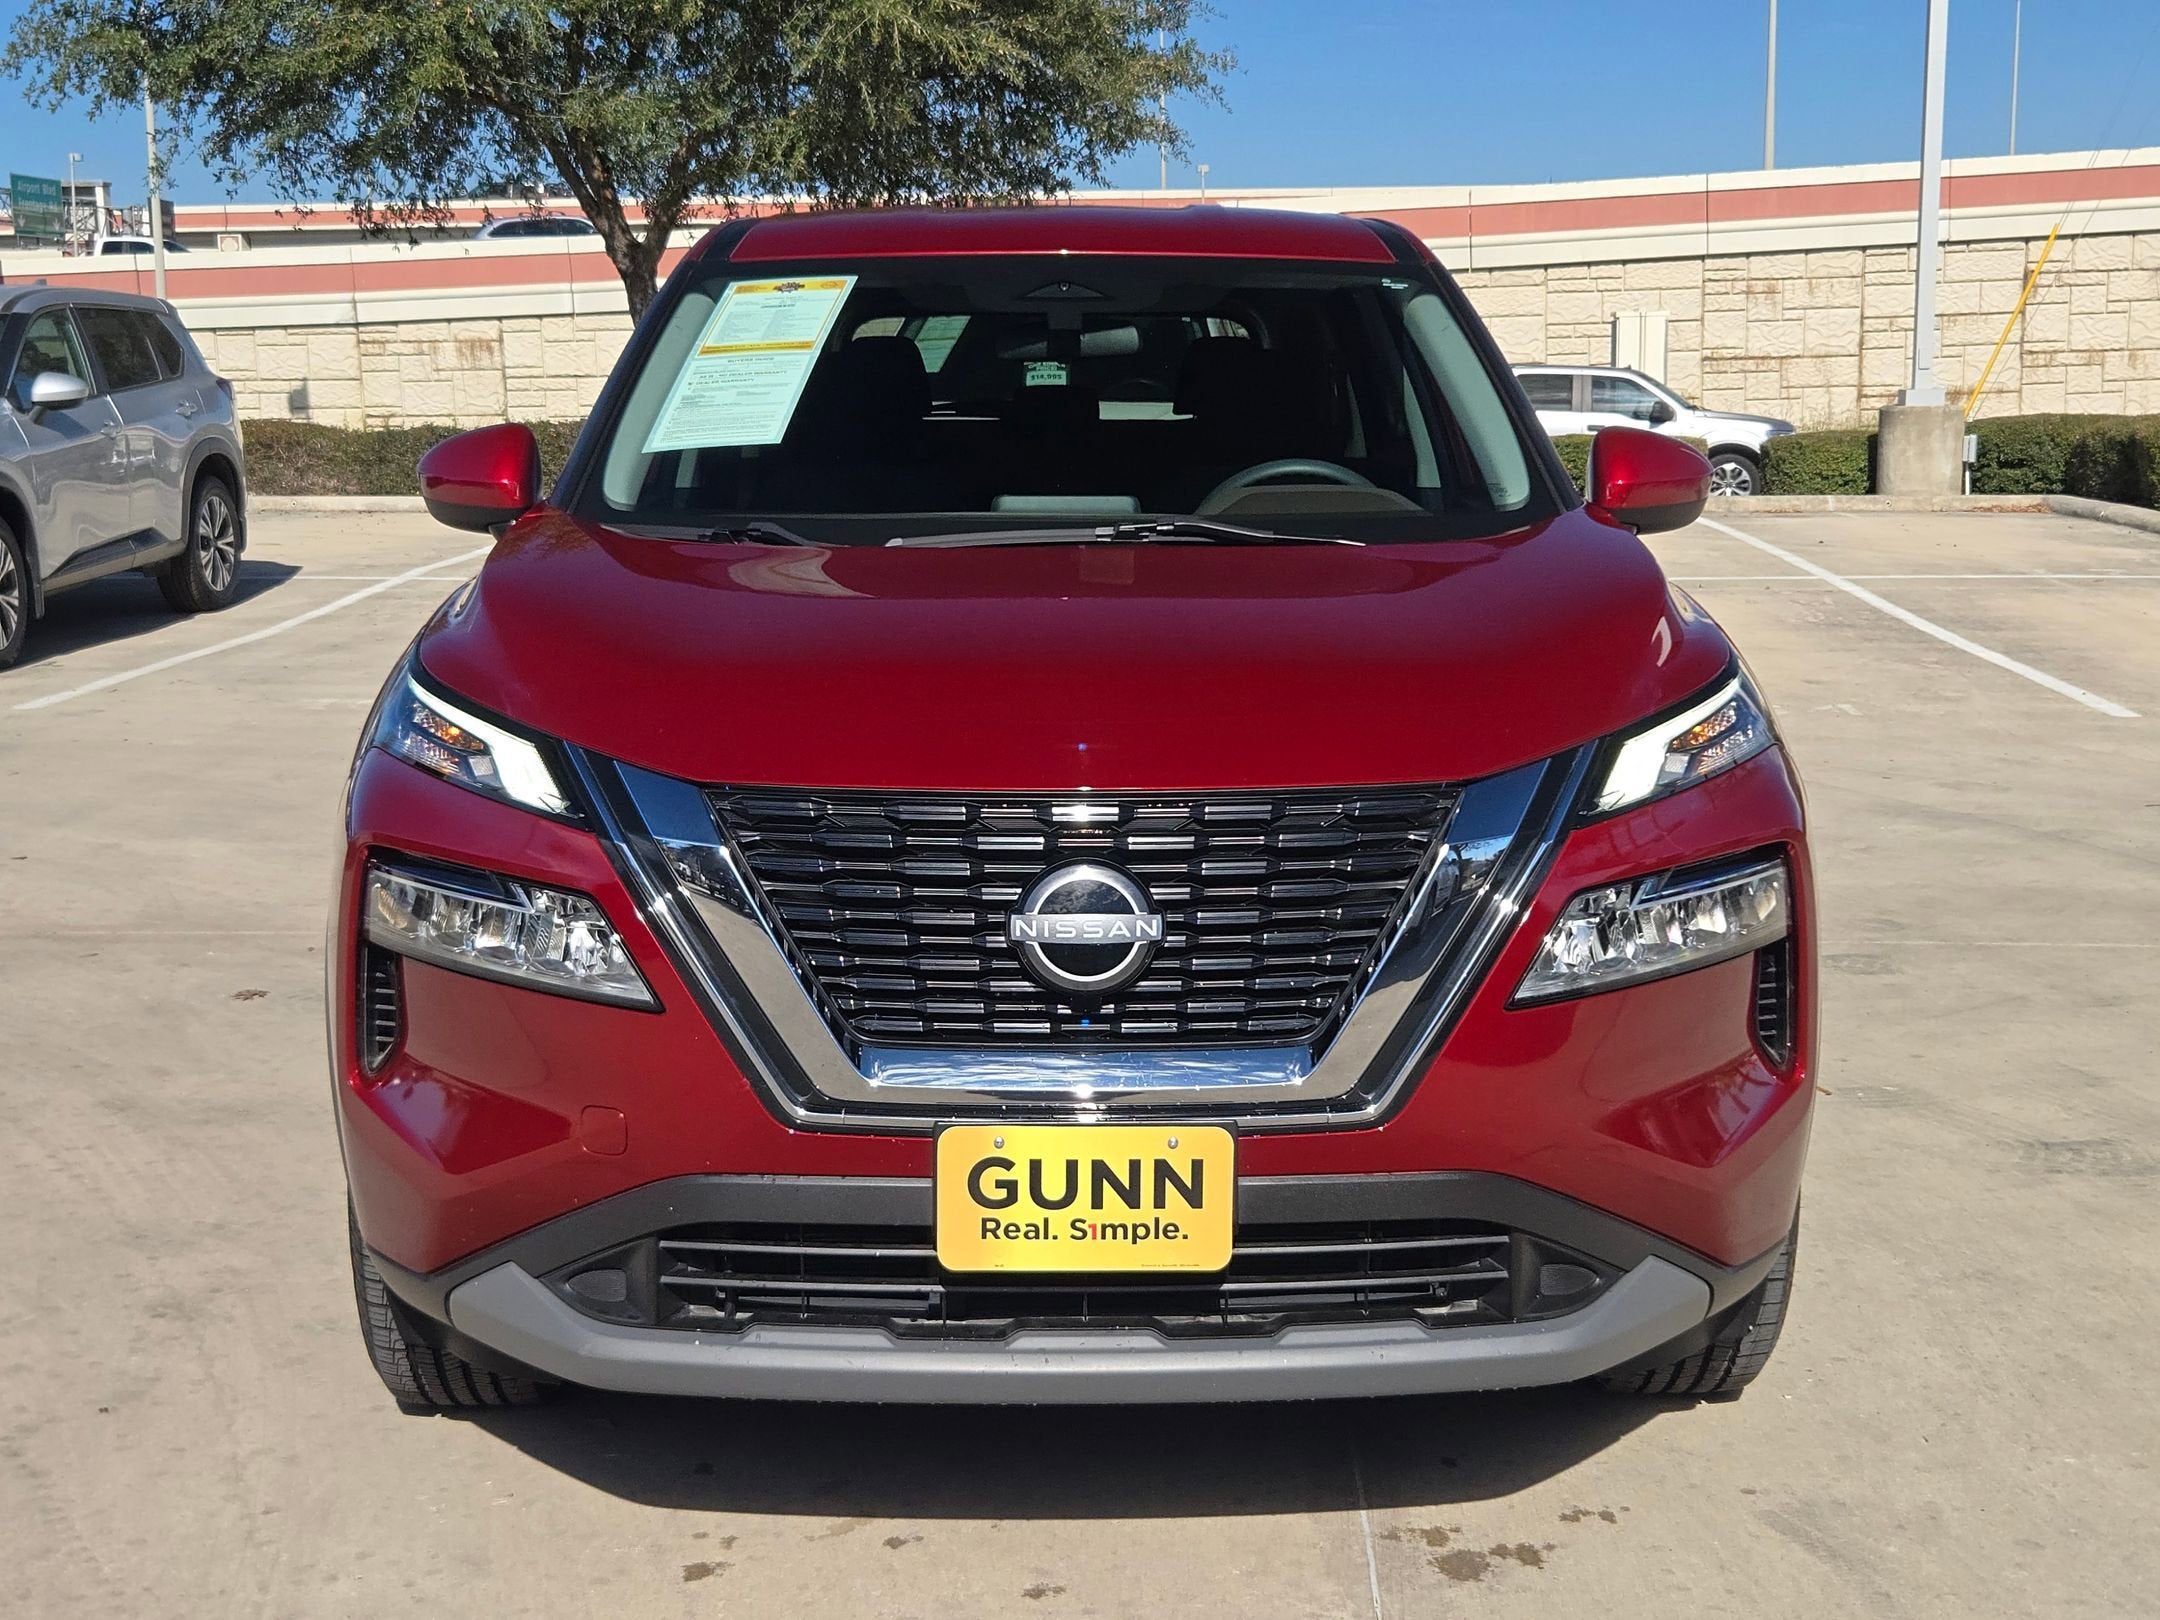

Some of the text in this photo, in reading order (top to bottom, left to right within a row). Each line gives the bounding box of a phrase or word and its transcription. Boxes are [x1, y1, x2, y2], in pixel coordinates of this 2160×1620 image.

[17, 181, 56, 195] Airport Blvd
[1014, 919, 1158, 938] NISSAN
[966, 1155, 1204, 1211] GUNN
[981, 1216, 1059, 1240] Real.
